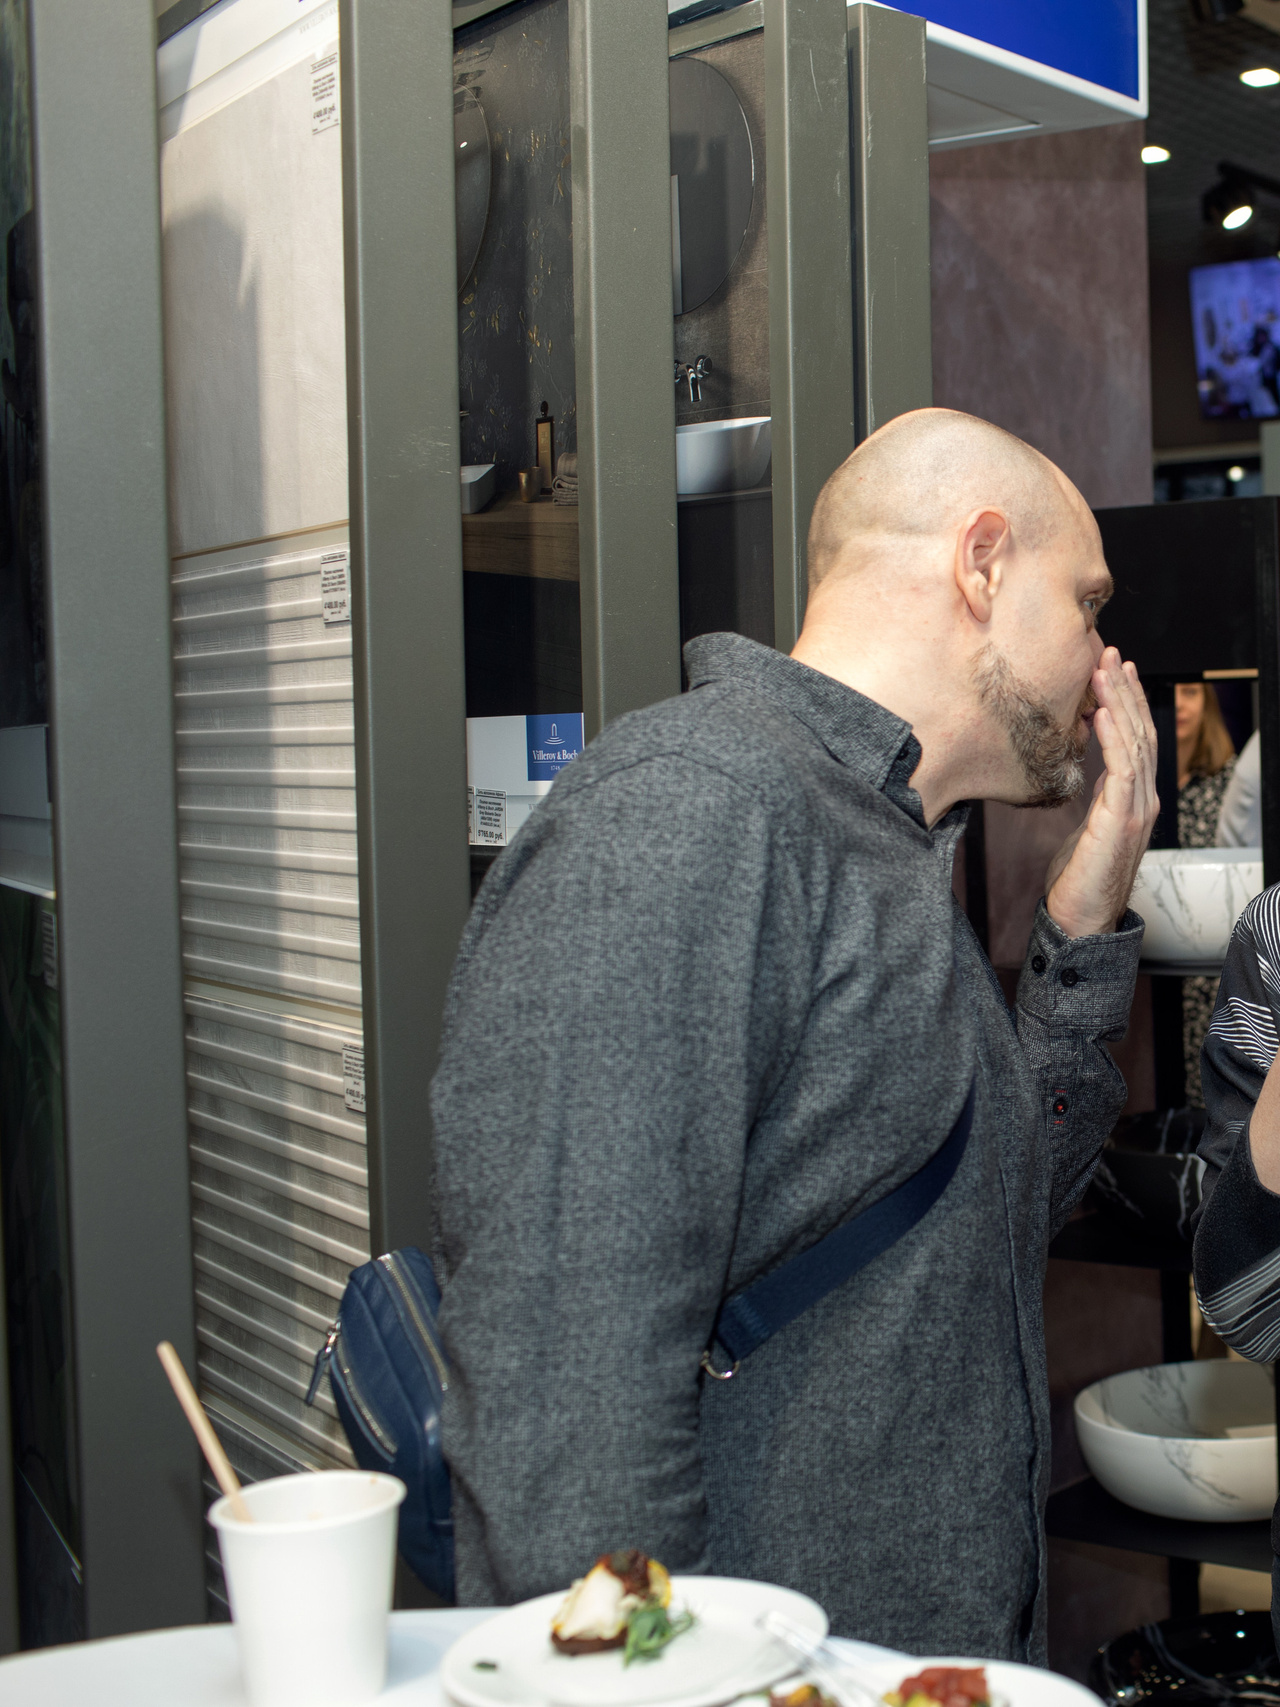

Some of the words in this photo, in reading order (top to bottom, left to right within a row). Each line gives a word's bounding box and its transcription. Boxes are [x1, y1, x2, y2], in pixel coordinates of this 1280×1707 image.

[532, 750, 556, 763] Villeroy
[557, 751, 562, 760] &
[562, 749, 579, 760] Boch
[495, 832, 504, 841] руб.
